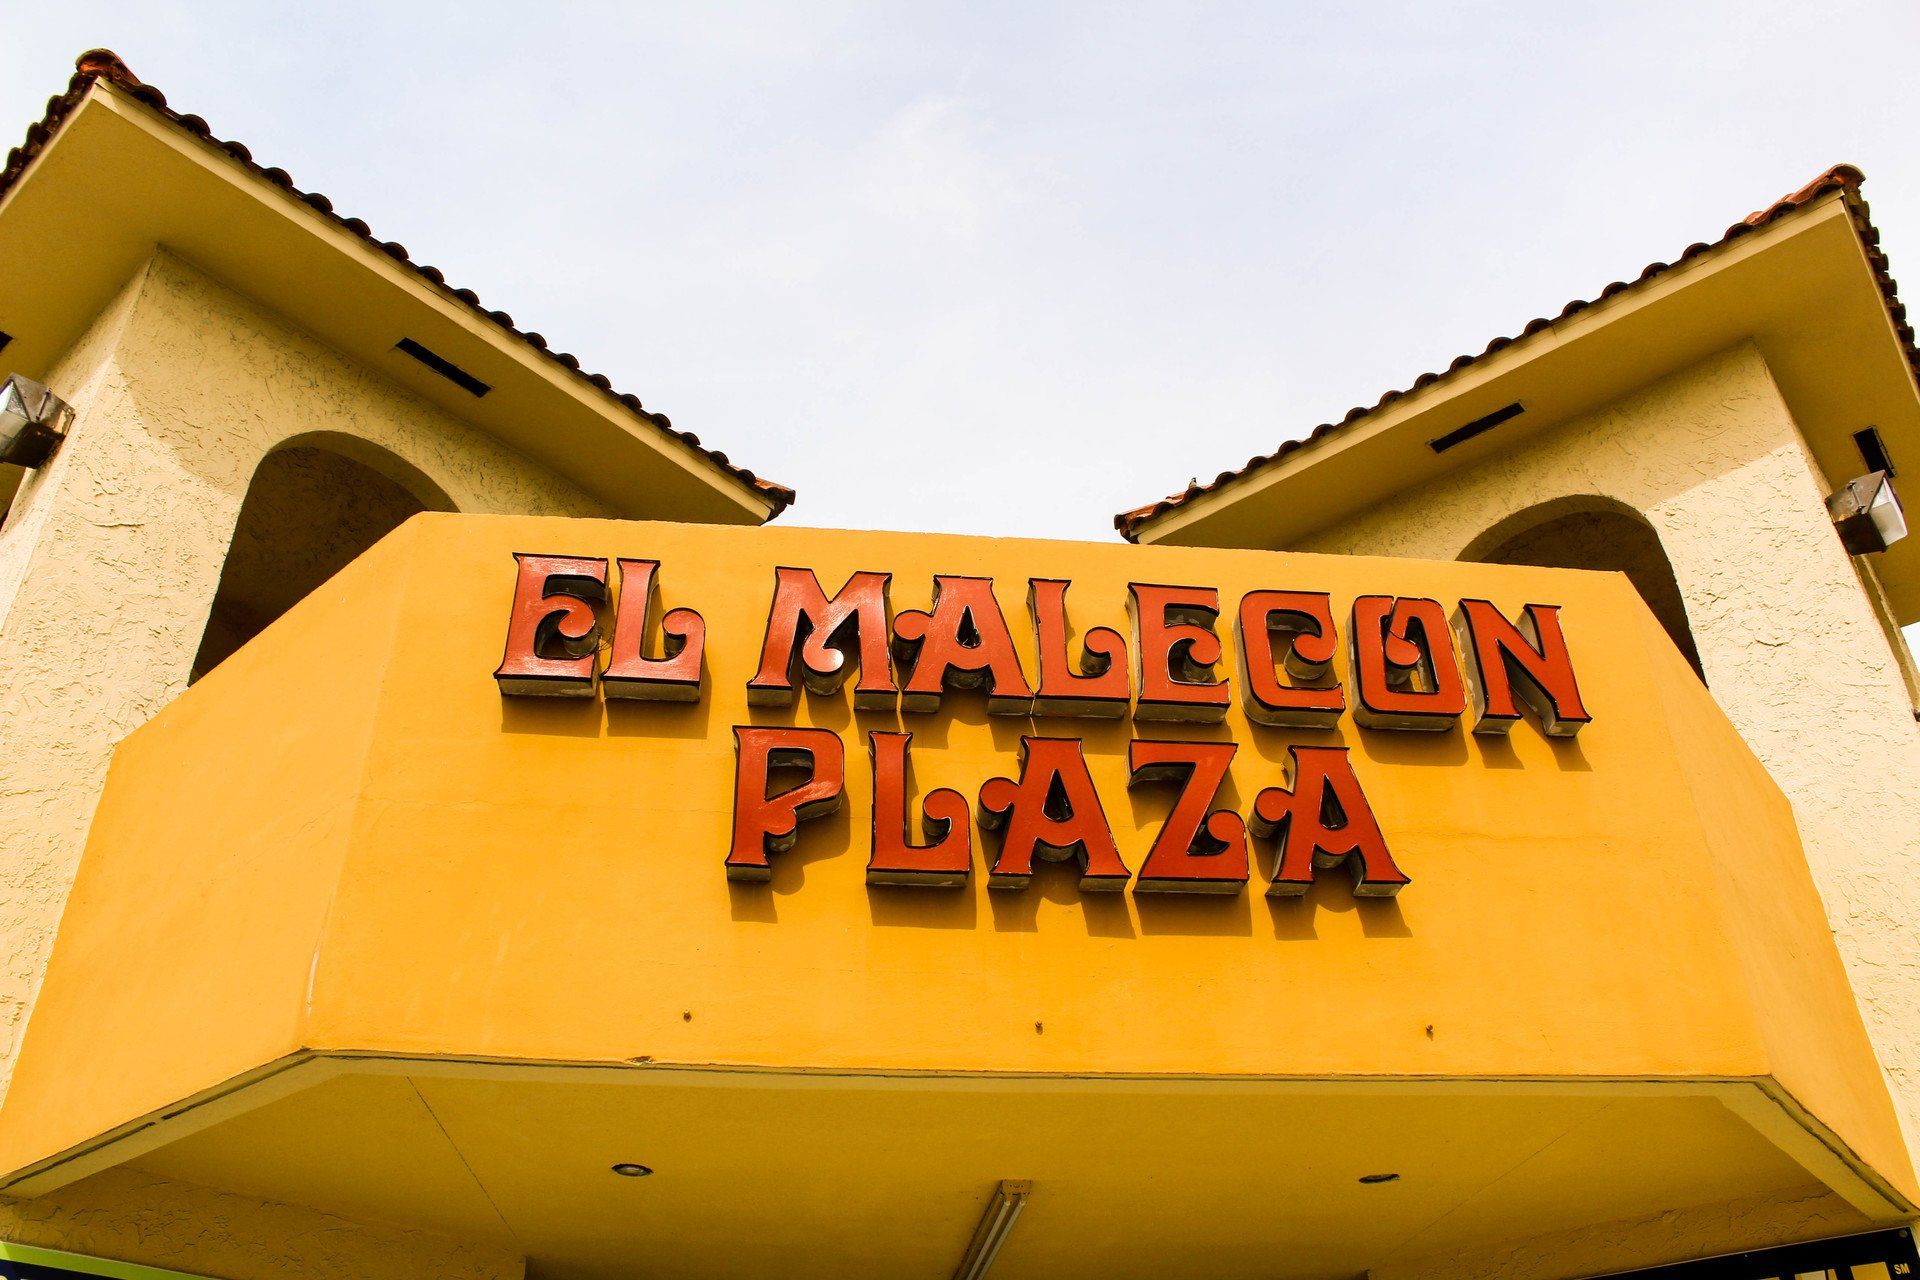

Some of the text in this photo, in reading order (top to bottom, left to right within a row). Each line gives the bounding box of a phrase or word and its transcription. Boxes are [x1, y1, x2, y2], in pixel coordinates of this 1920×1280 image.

[493, 552, 1592, 738] EL MALECON
[726, 726, 1411, 898] PLAZA
[1894, 1263, 1910, 1275] SM
